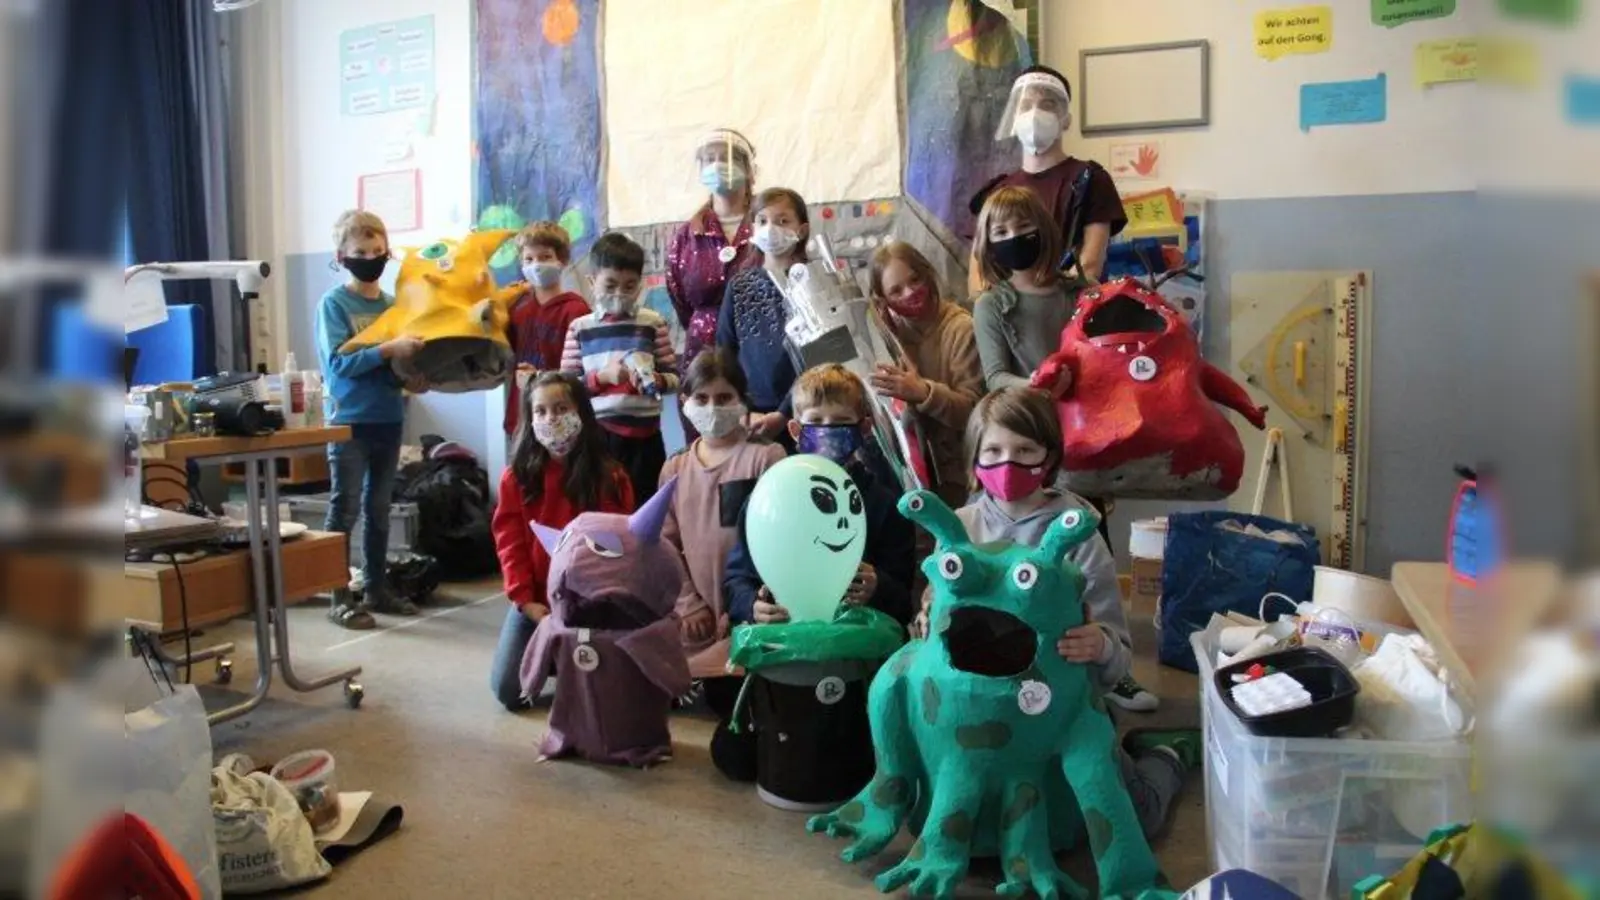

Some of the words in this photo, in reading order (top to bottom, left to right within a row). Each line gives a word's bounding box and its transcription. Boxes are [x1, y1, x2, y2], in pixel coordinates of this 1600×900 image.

[1265, 18, 1283, 28] Wir
[1286, 16, 1320, 27] achten
[1258, 35, 1275, 46] auf
[1276, 35, 1295, 45] den
